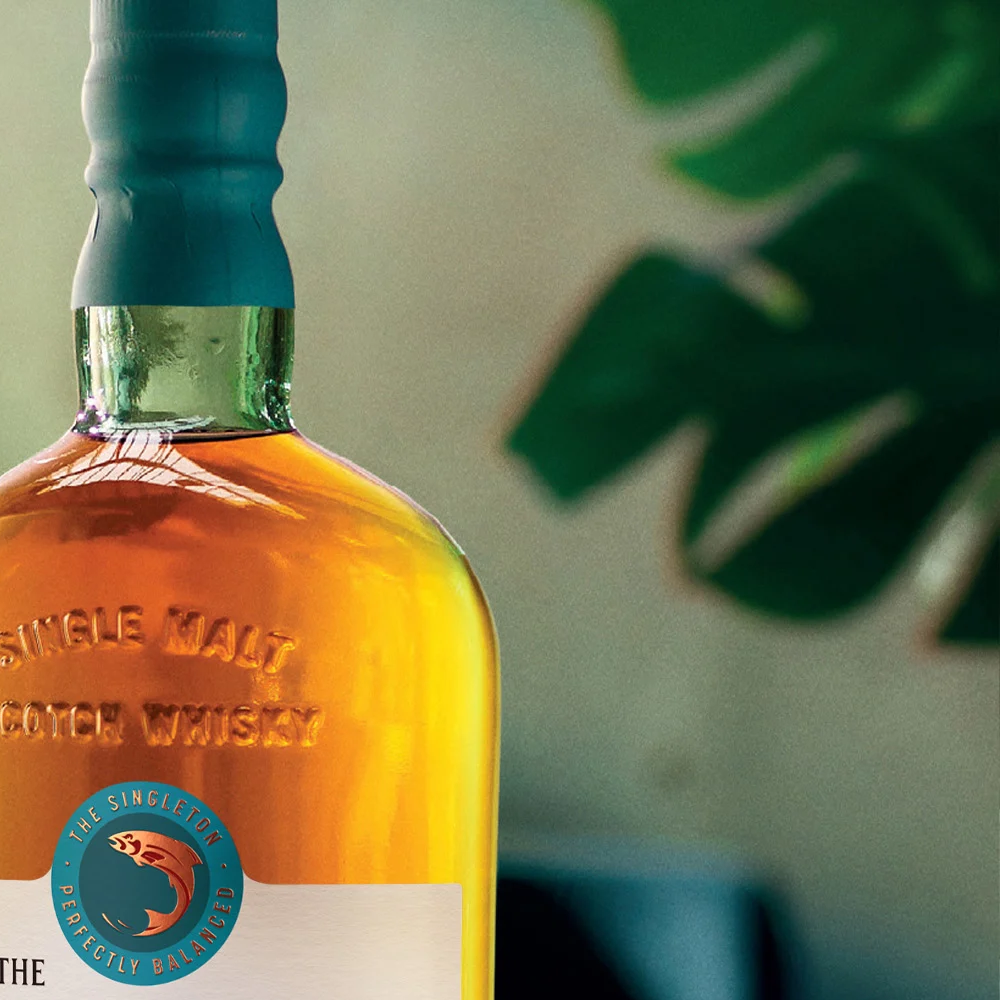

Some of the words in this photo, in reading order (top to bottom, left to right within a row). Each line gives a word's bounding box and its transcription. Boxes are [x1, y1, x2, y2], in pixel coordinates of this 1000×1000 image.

[162, 603, 297, 673] MALT
[141, 703, 325, 747] WHISKY
[69, 806, 102, 843] THE
[107, 789, 223, 847] SINGLETON
[59, 884, 140, 976] PERFECTLY
[152, 887, 235, 976] BALANCED
